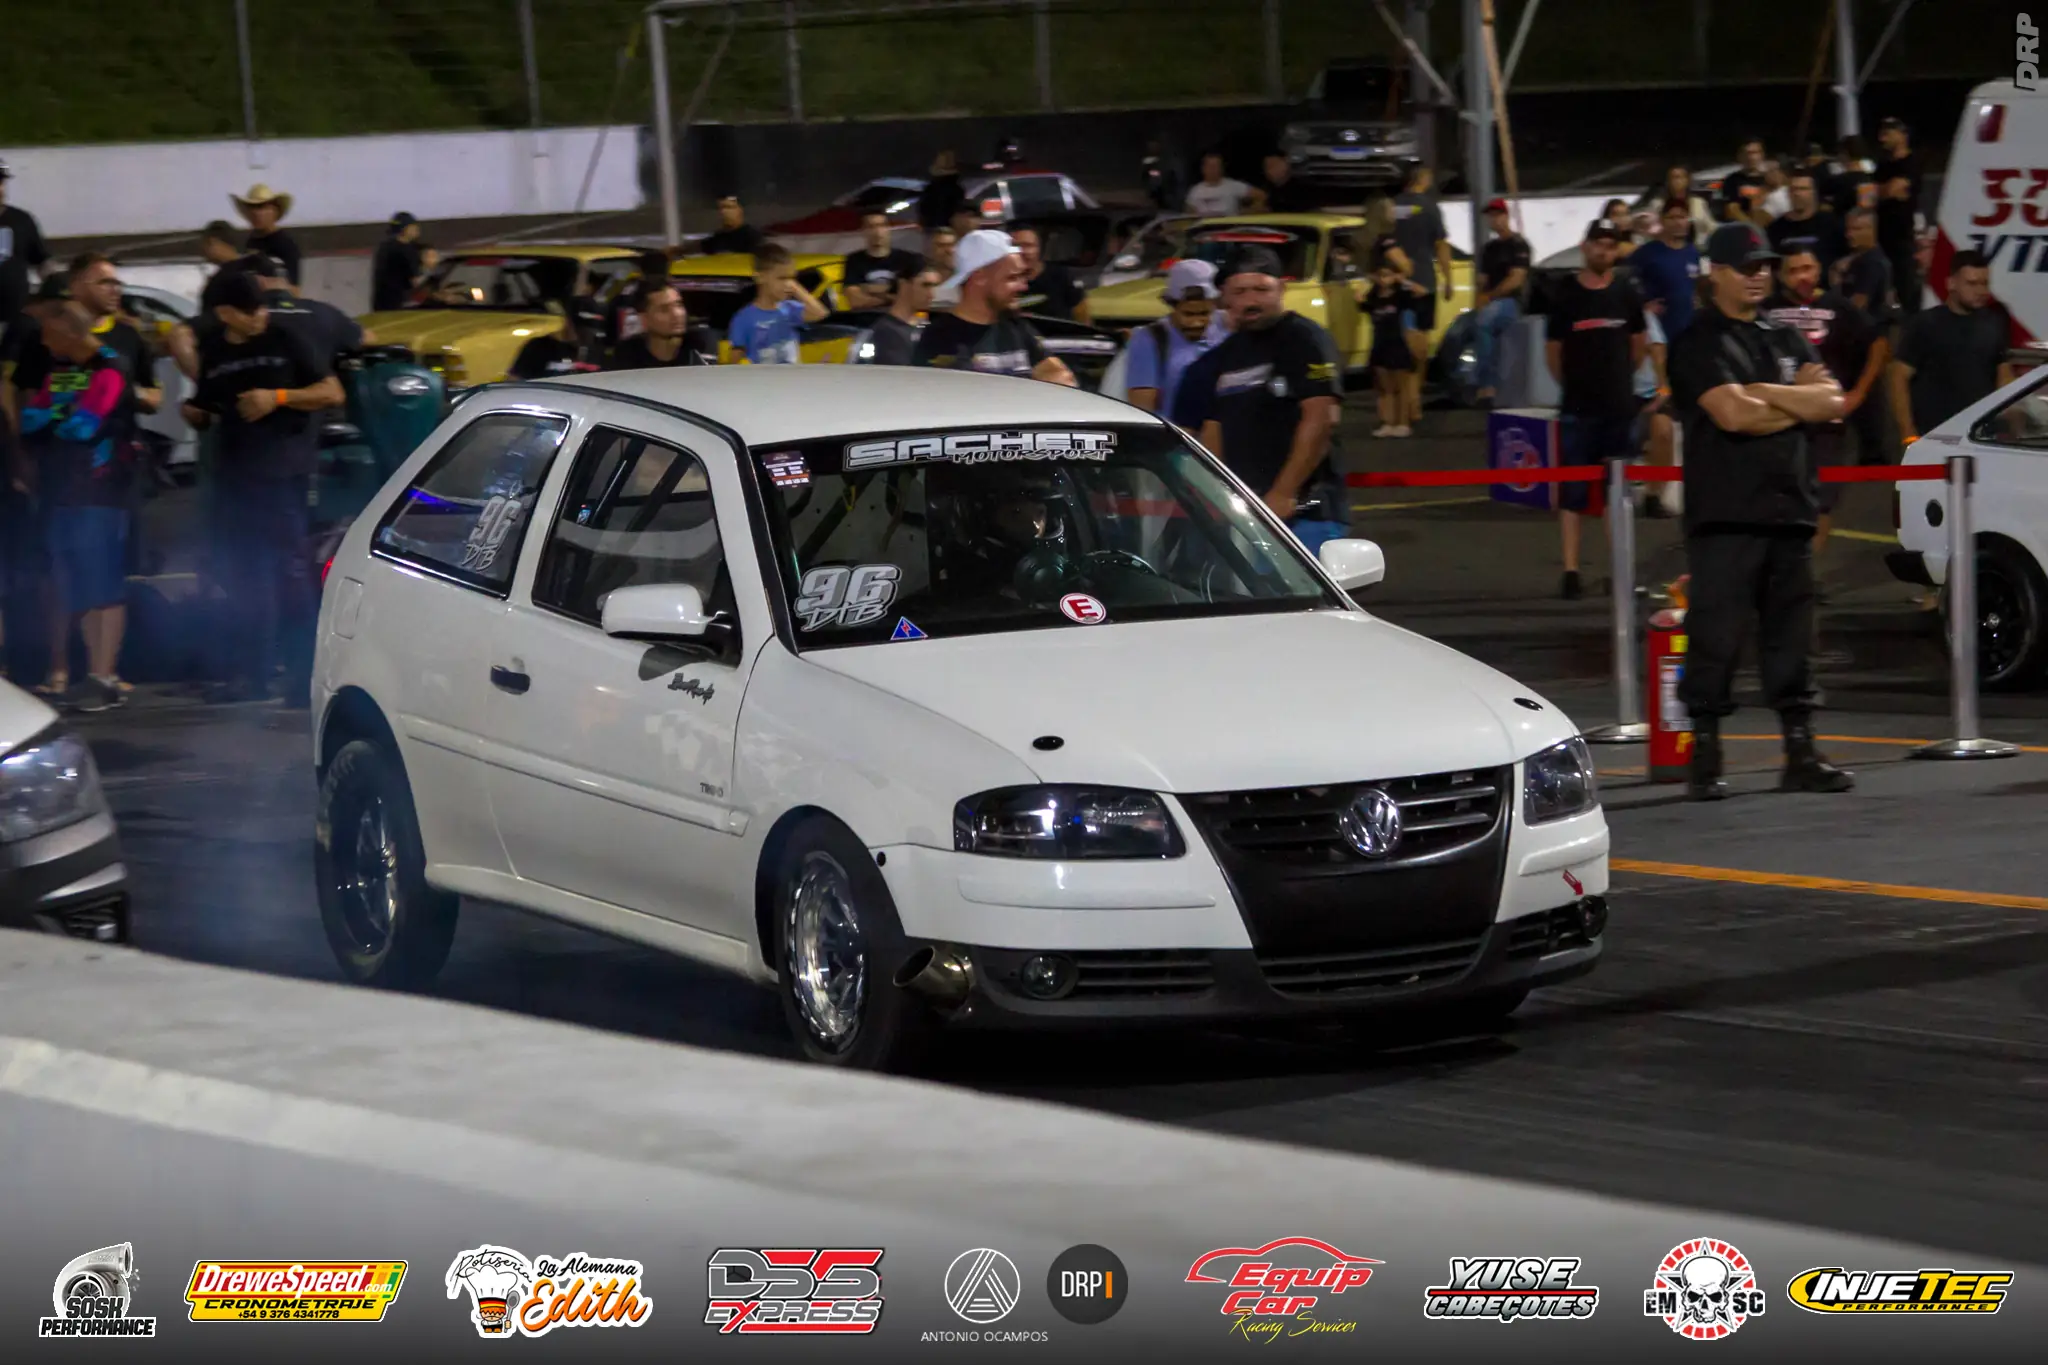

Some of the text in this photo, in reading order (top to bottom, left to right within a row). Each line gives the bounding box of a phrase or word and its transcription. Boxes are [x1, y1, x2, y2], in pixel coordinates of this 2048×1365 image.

[848, 432, 1112, 468] SACHET
[952, 449, 1110, 464] MOTORSPORT
[469, 496, 521, 544] 96
[796, 566, 900, 611] 96
[1067, 598, 1099, 618] E
